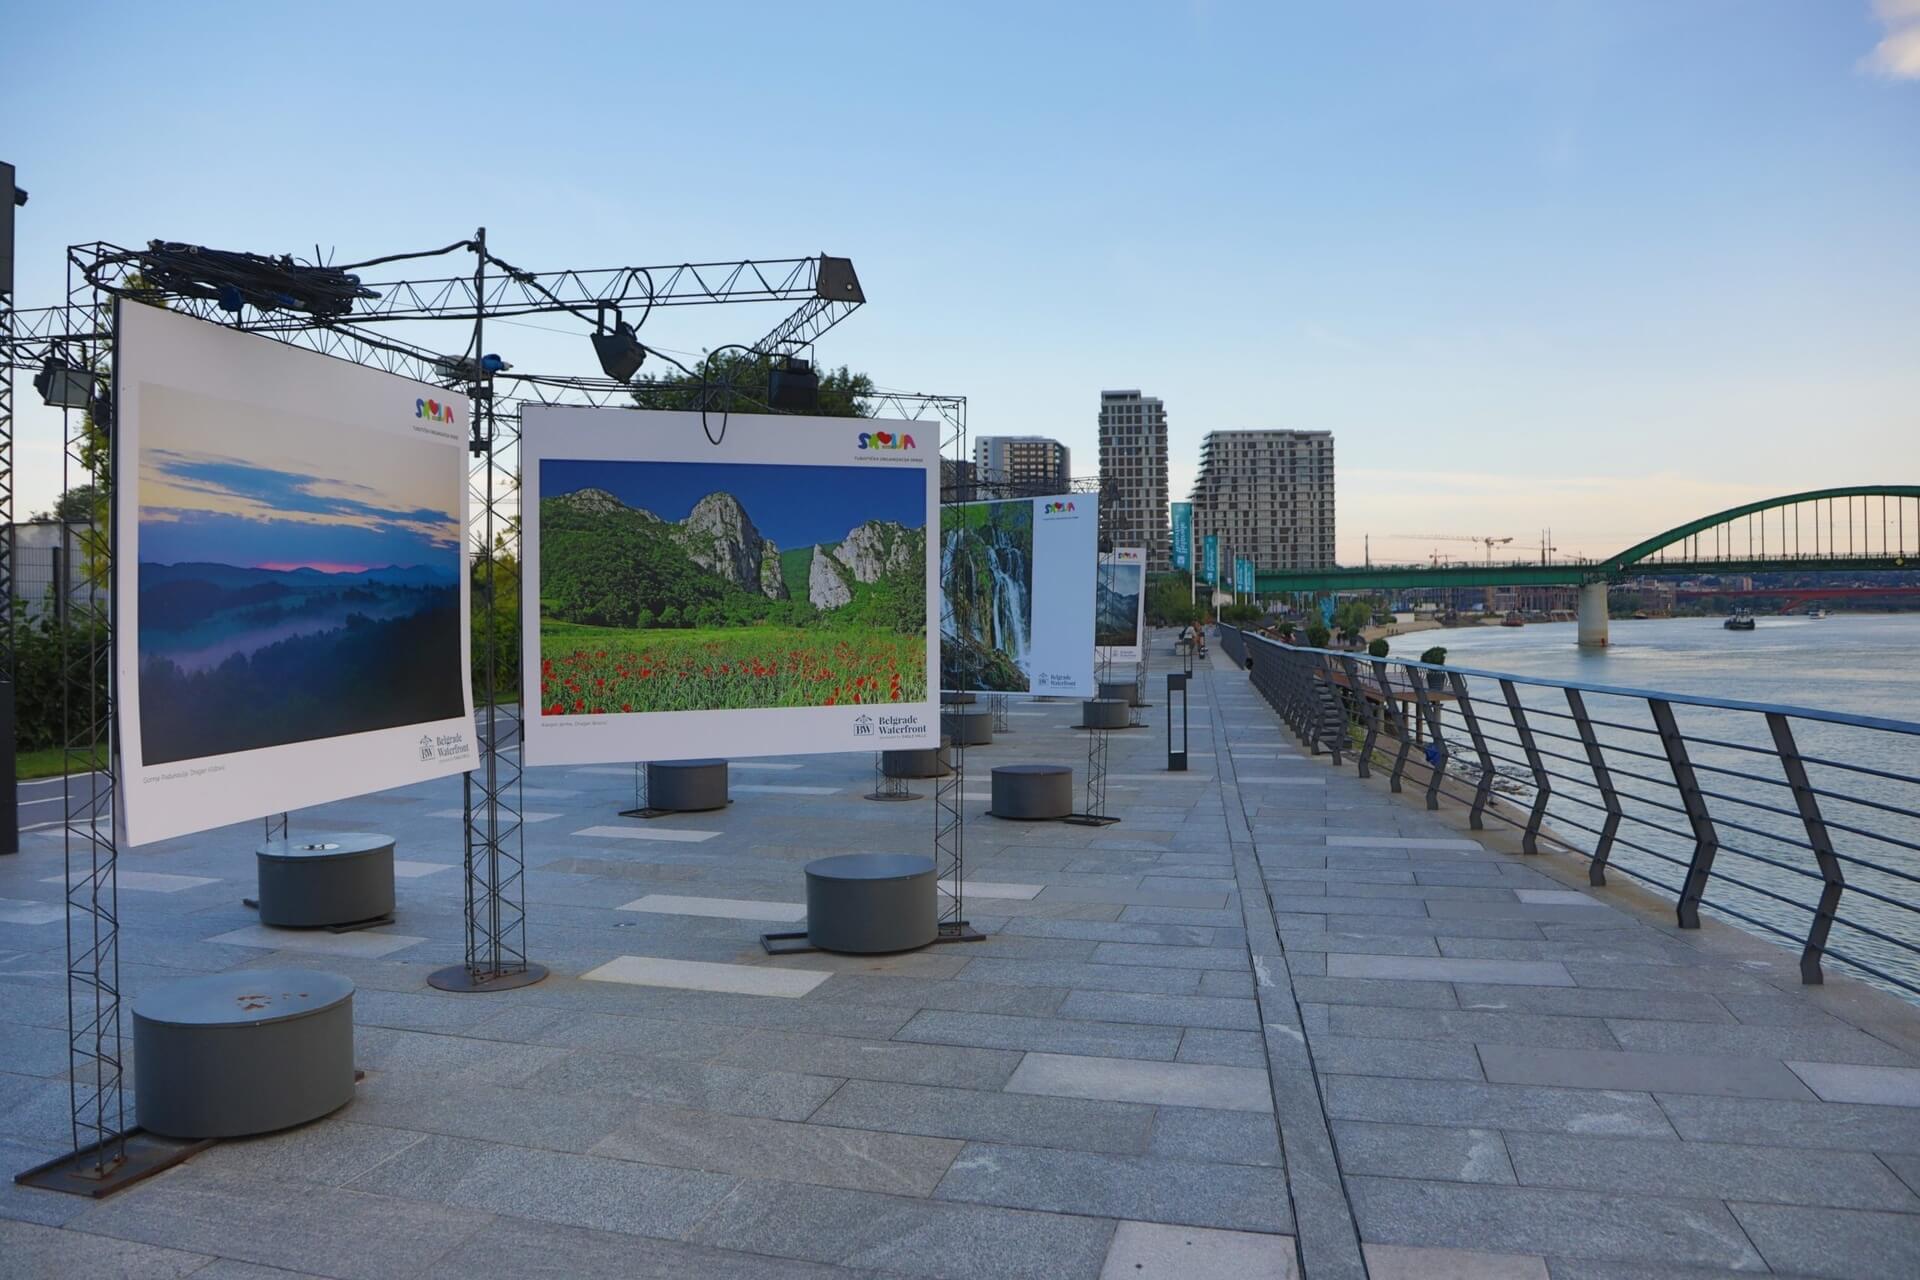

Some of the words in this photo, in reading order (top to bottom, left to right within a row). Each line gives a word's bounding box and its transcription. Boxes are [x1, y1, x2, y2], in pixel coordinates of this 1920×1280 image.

[878, 715, 918, 726] Belgrade
[856, 725, 872, 735] BW
[878, 725, 927, 735] Waterfront
[436, 732, 463, 746] Belgrade
[437, 743, 470, 757] Waterfront
